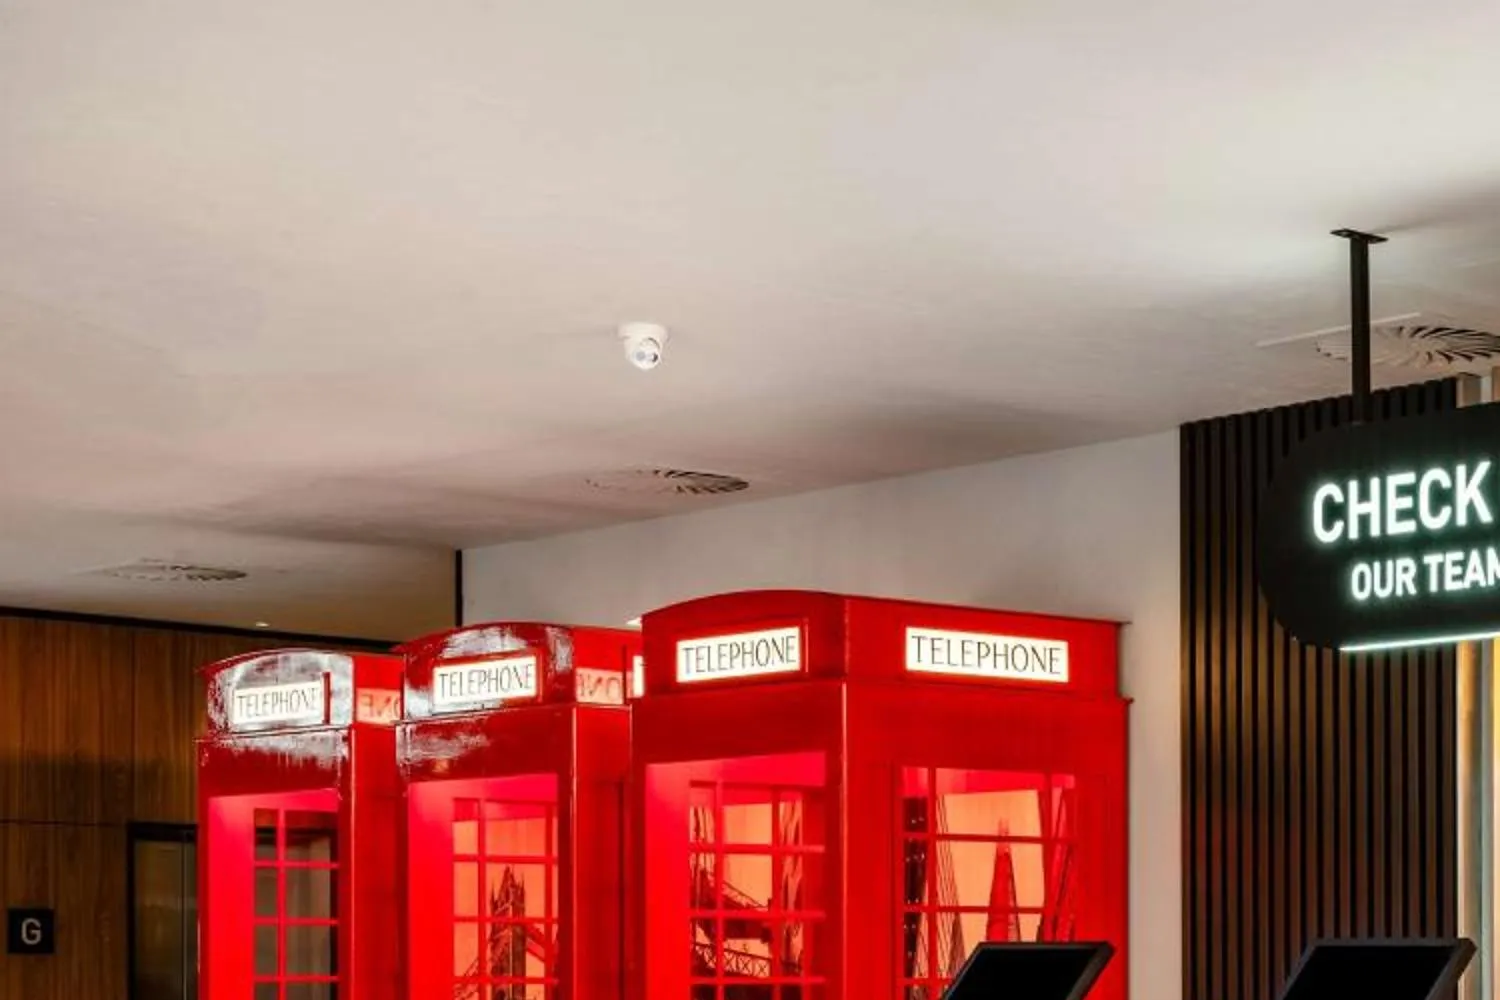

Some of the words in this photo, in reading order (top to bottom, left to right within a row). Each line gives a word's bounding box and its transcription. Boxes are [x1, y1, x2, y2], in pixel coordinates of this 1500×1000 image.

[1312, 460, 1494, 544] CHECK
[1350, 556, 1418, 601] OUR
[682, 635, 797, 675] TELEPHONE
[911, 635, 1061, 674] TELEPHONE
[438, 663, 535, 698] TELEPHONE
[236, 687, 319, 718] TELEPHONE
[21, 918, 42, 945] G
